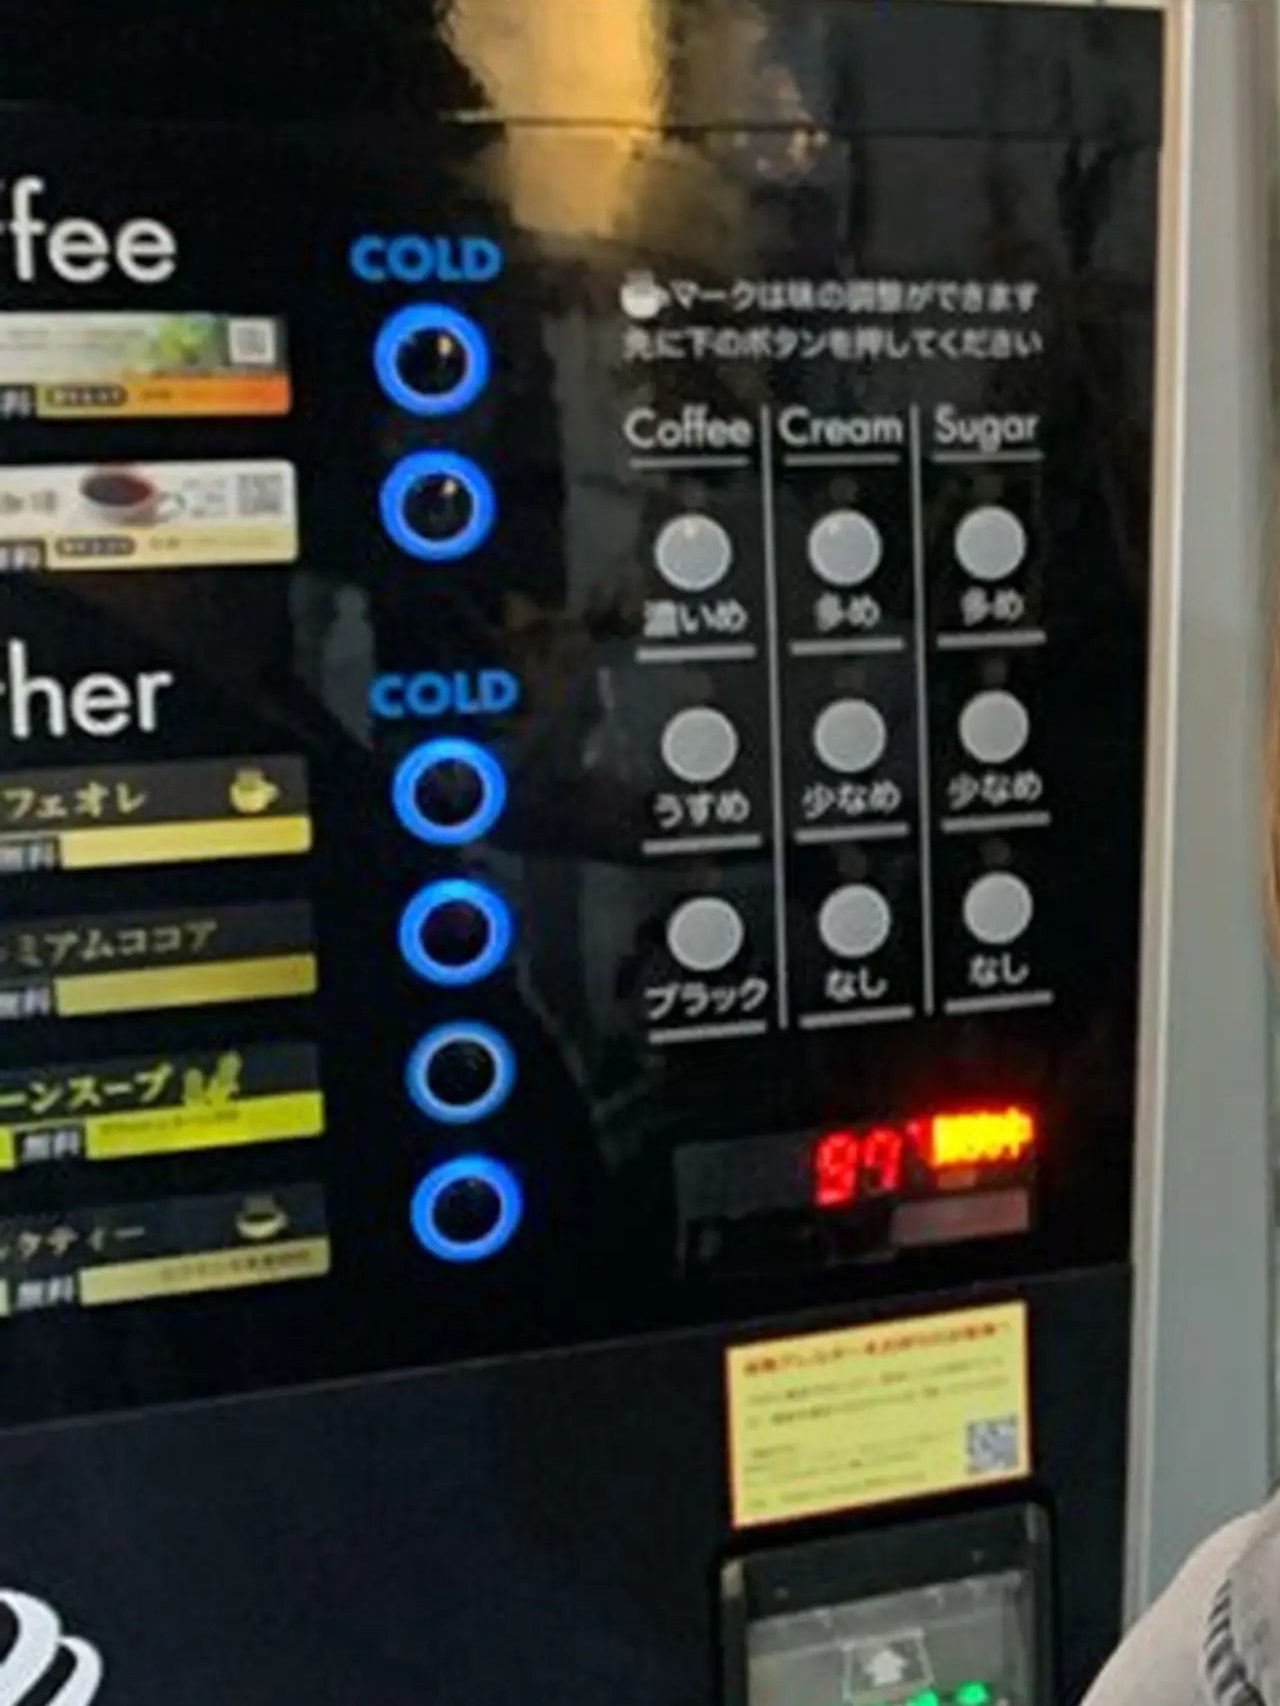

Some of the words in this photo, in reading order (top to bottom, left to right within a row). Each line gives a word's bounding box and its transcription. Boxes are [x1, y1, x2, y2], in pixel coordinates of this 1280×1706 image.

[0, 177, 176, 282] fee
[350, 235, 502, 282] COLD
[623, 405, 751, 449] Coffee
[779, 406, 904, 444] Cream
[935, 404, 1038, 453] Sugar
[815, 593, 881, 631] 多め
[960, 588, 1024, 625] 多め
[0, 638, 173, 738] her
[368, 670, 518, 718] COLD
[654, 791, 749, 828] うすめ
[802, 779, 900, 819] 少なめ
[948, 770, 1042, 809] 少なめ
[0, 921, 217, 968] ミアムココア
[826, 968, 887, 1002] なし
[969, 953, 1029, 987] なし
[645, 977, 768, 1020] ブラック
